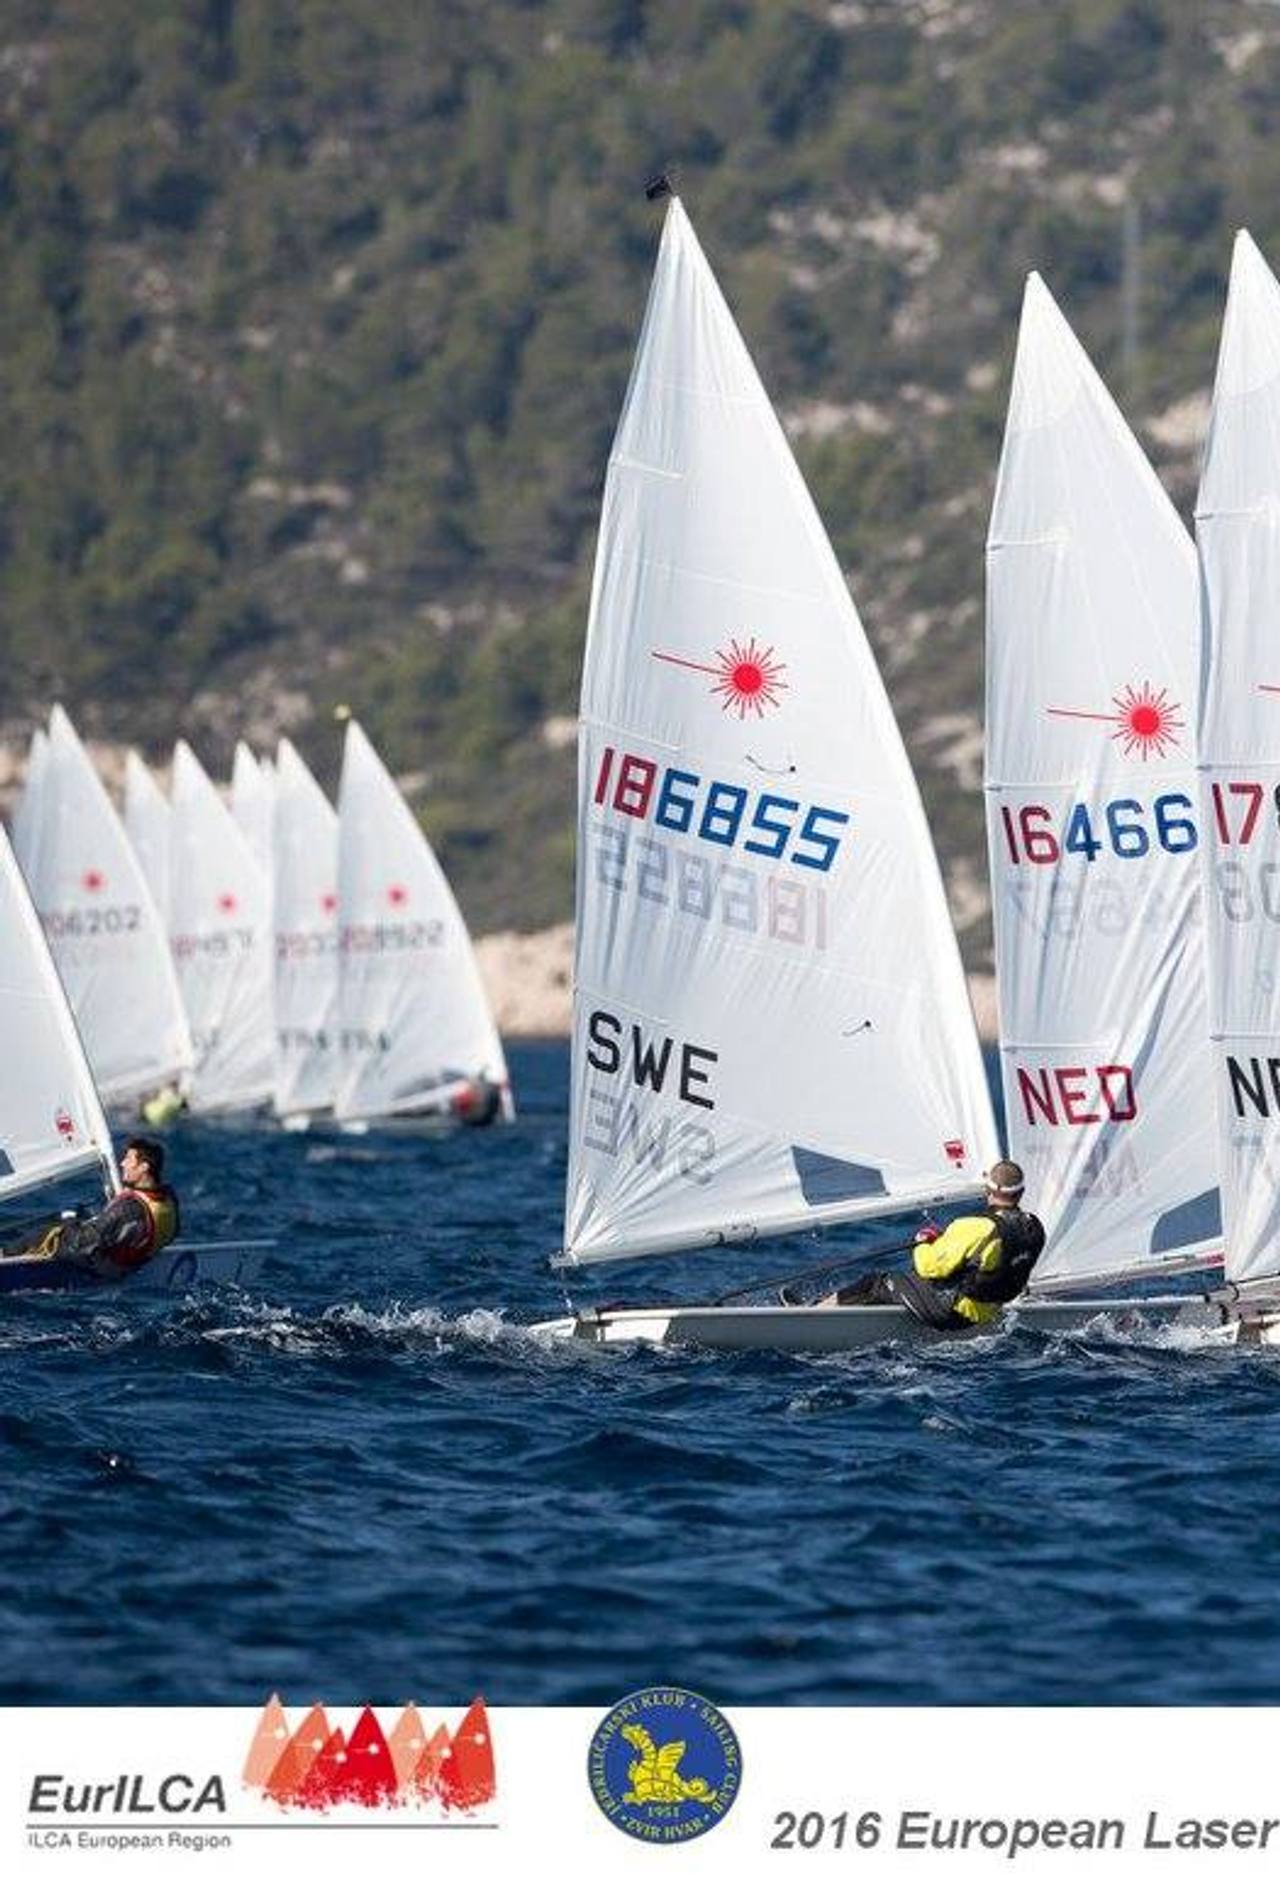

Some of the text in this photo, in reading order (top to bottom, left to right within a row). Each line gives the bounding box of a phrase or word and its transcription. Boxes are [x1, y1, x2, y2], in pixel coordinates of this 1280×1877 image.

[595, 747, 850, 872] 186855
[587, 1010, 718, 1110] SWE
[1018, 1065, 1138, 1126] NED
